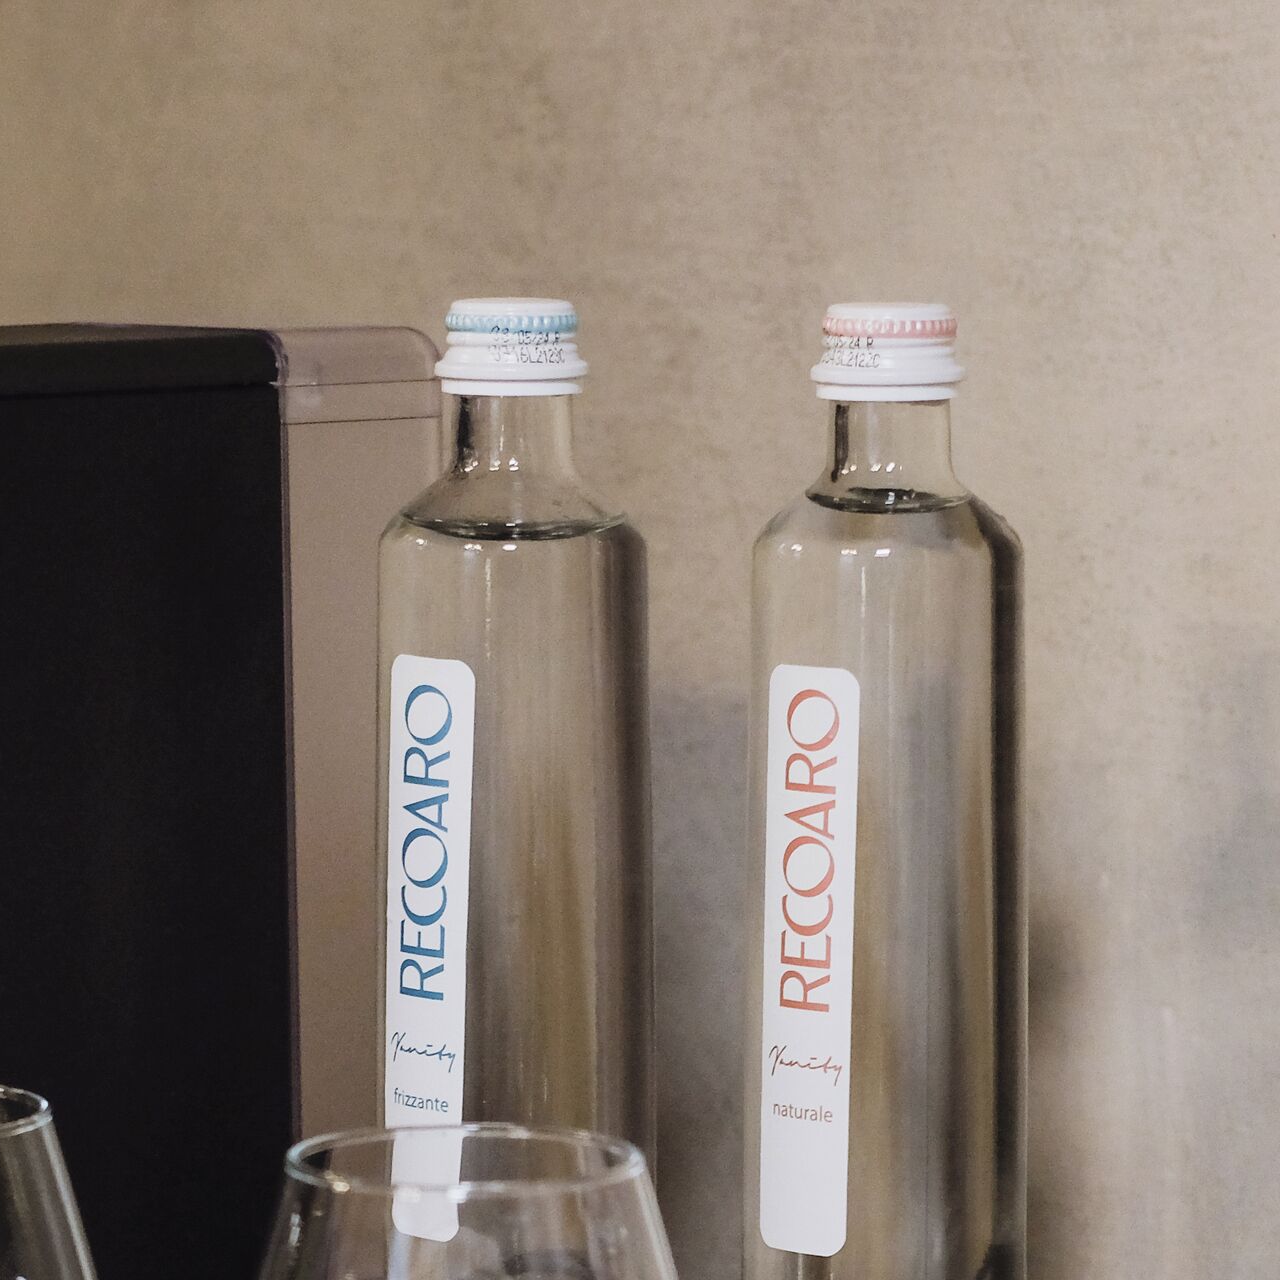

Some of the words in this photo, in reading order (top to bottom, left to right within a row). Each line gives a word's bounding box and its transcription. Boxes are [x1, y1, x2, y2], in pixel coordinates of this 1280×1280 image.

[399, 684, 453, 1001] RECOARO
[779, 689, 840, 1013] RECOARO
[393, 1087, 449, 1113] frizzante
[772, 1103, 834, 1123] naturale
